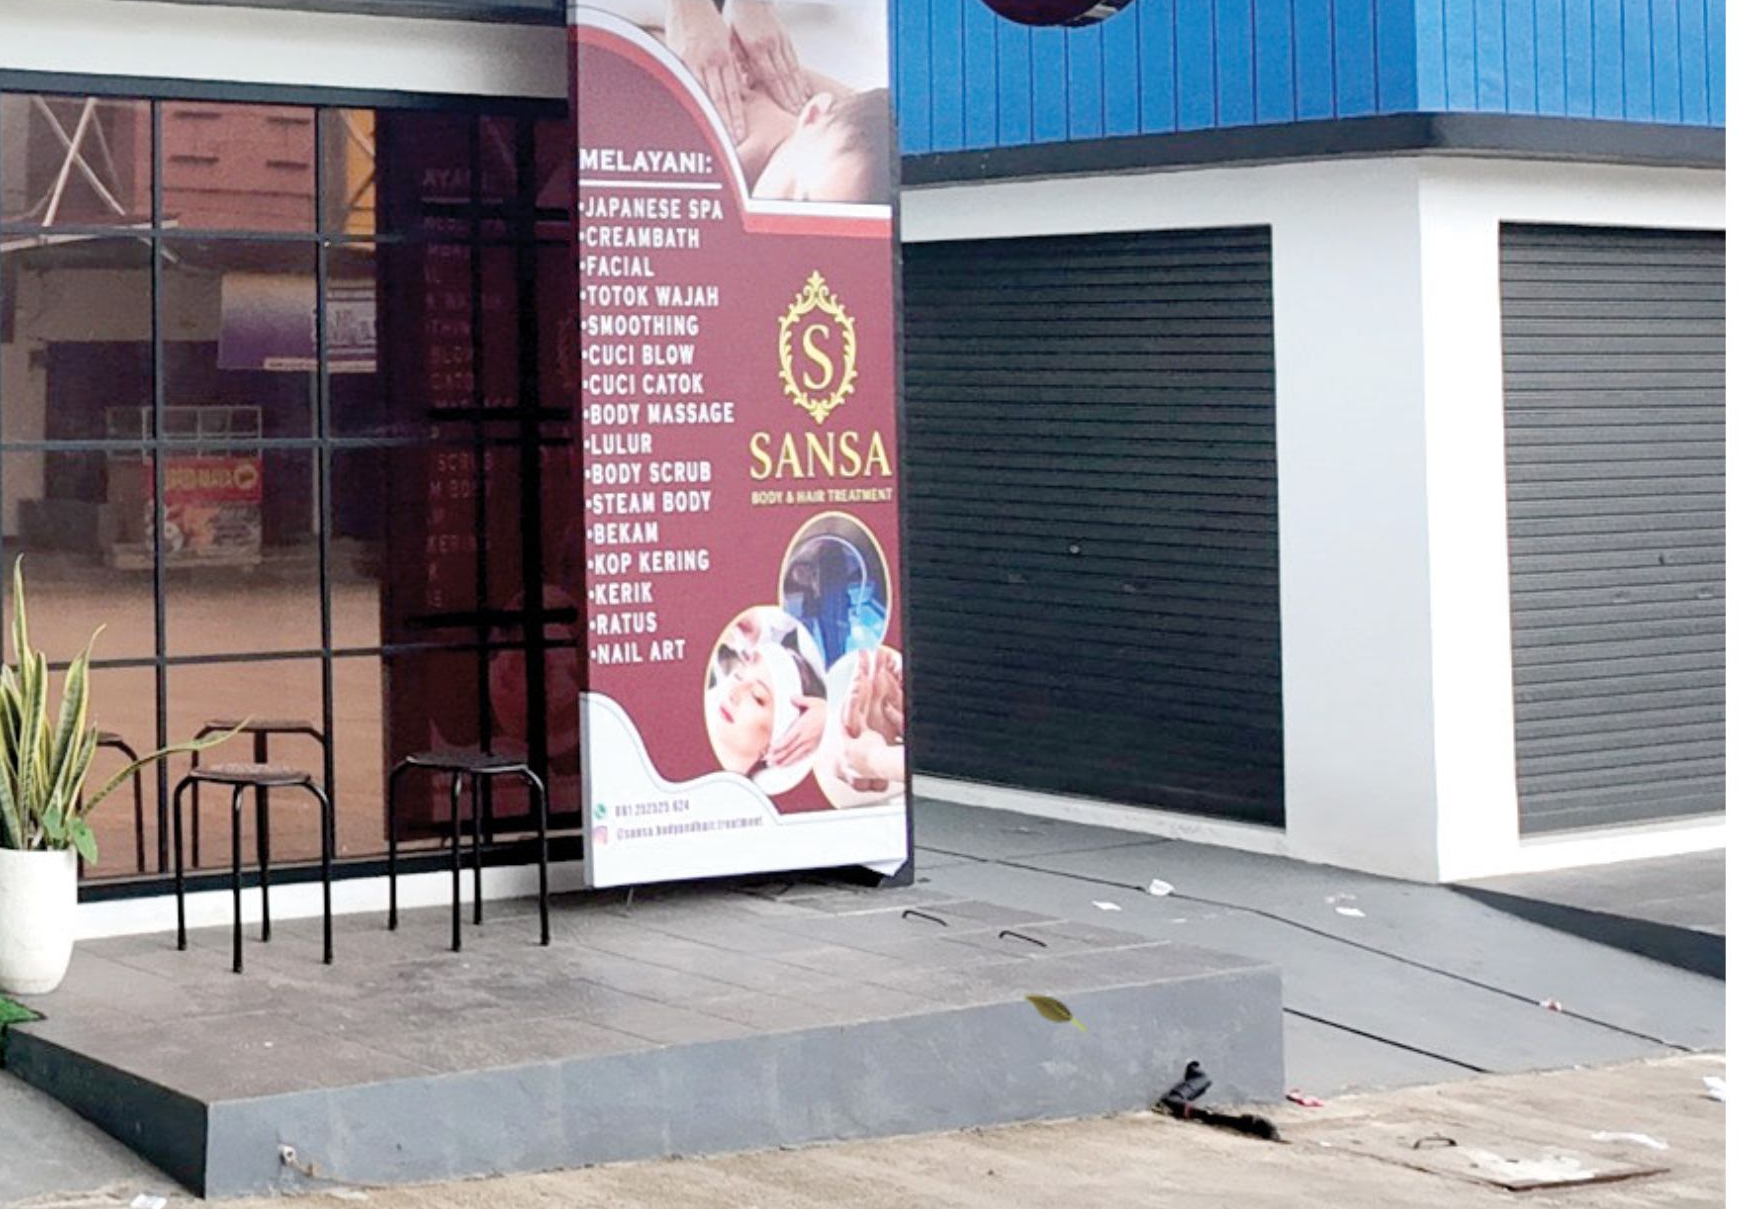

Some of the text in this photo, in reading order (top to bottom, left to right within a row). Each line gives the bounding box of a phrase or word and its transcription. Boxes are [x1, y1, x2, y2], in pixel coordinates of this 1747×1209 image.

[579, 148, 713, 175] MELAYANI:
[585, 196, 724, 220] JAPANESE SPA
[586, 225, 700, 249] CREAMBATH
[586, 255, 655, 277] FACIAL
[586, 285, 719, 307] TOTOK WAJAH
[587, 314, 699, 336] SMOOTHING
[588, 344, 695, 366] CUCI BLOW
[802, 323, 835, 390] S
[589, 373, 704, 395] CUCI CATOK
[590, 401, 735, 426] BODY MASSAGE
[590, 432, 652, 455] LULUR
[749, 430, 893, 480] SANSA
[591, 461, 711, 485] BODY SCRUB
[592, 490, 712, 515] STEAM BODY
[751, 487, 893, 504] BODY & HAIR TREATMENT
[593, 521, 659, 545] BEKAM
[594, 549, 710, 576] KOP KERING
[595, 581, 653, 605] KERIK
[596, 611, 658, 635] RATUS
[597, 639, 686, 665] NAIL ART
